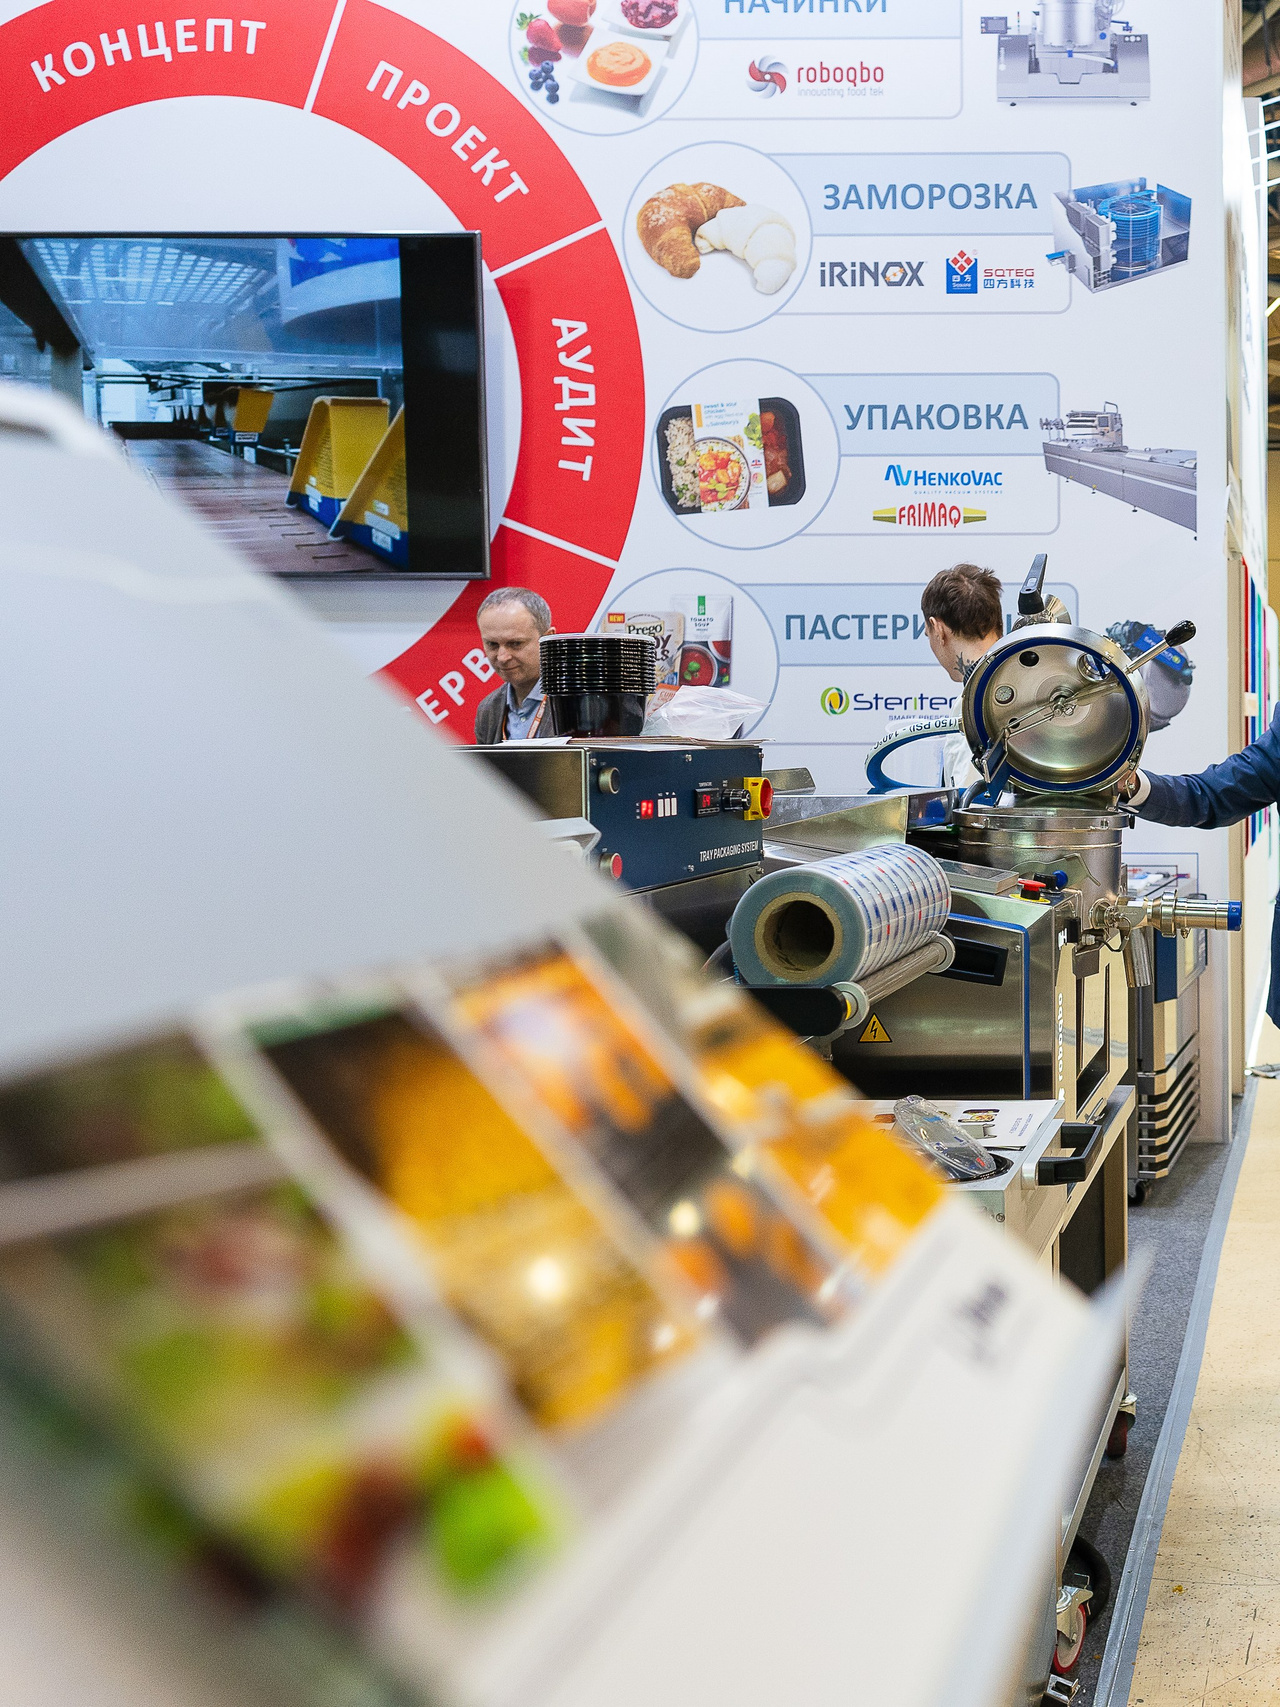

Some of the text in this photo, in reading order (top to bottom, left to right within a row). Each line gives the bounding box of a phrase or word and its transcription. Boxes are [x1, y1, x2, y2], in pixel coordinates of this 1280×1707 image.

[30, 17, 267, 93] КОНЦЕПТ
[797, 61, 885, 87] roboqbo
[797, 86, 884, 98] innovating food tek
[366, 60, 530, 204] ПРОЕКТ
[823, 183, 1038, 211] ЗАМОРОЗКА
[983, 268, 1035, 277] SQTEG
[983, 278, 1035, 289] 四方科技
[551, 316, 597, 482] АУДИТ
[843, 404, 1029, 431] УПАКОВКА
[898, 502, 961, 528] FRIMAQ
[627, 623, 663, 637] Prego
[415, 648, 496, 725] ЕРВ
[909, 720, 931, 733] PSI)
[934, 718, 957, 729] (150
[699, 840, 759, 862] TRAY PACKAGING SYSTEM
